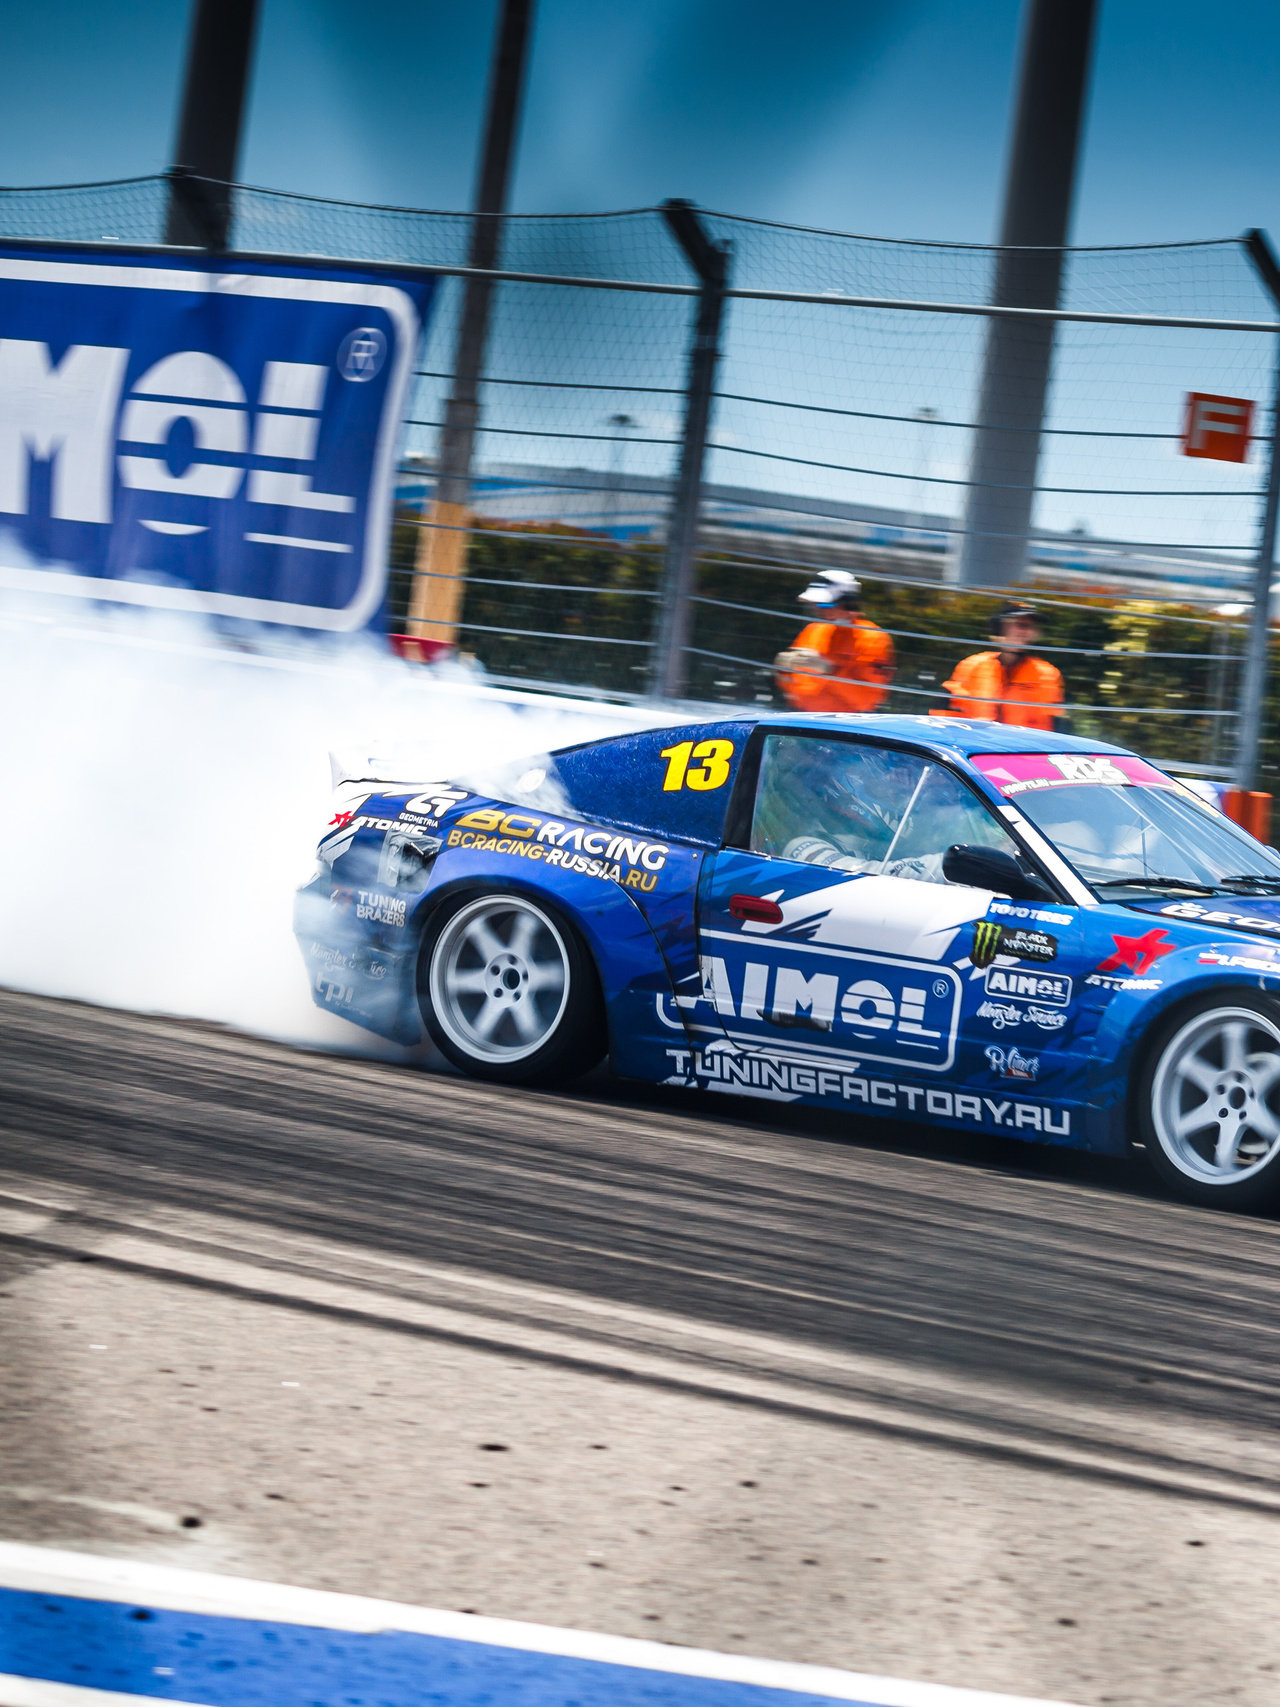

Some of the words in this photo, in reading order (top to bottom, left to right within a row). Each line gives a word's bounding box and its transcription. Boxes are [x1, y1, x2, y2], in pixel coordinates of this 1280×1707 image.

[1189, 400, 1250, 450] F
[660, 739, 734, 792] 13
[350, 816, 428, 836] ATOMIC
[399, 812, 439, 828] GEOMETRIA
[447, 830, 658, 891] BCRACING-RUSSIA.RU
[357, 890, 407, 914] TUNING
[990, 903, 1029, 918] TOYO
[356, 904, 405, 928] BRAZERS
[989, 972, 1066, 1000] AIMOL
[665, 1048, 1071, 1136] TUNINGFACTORY.RU
